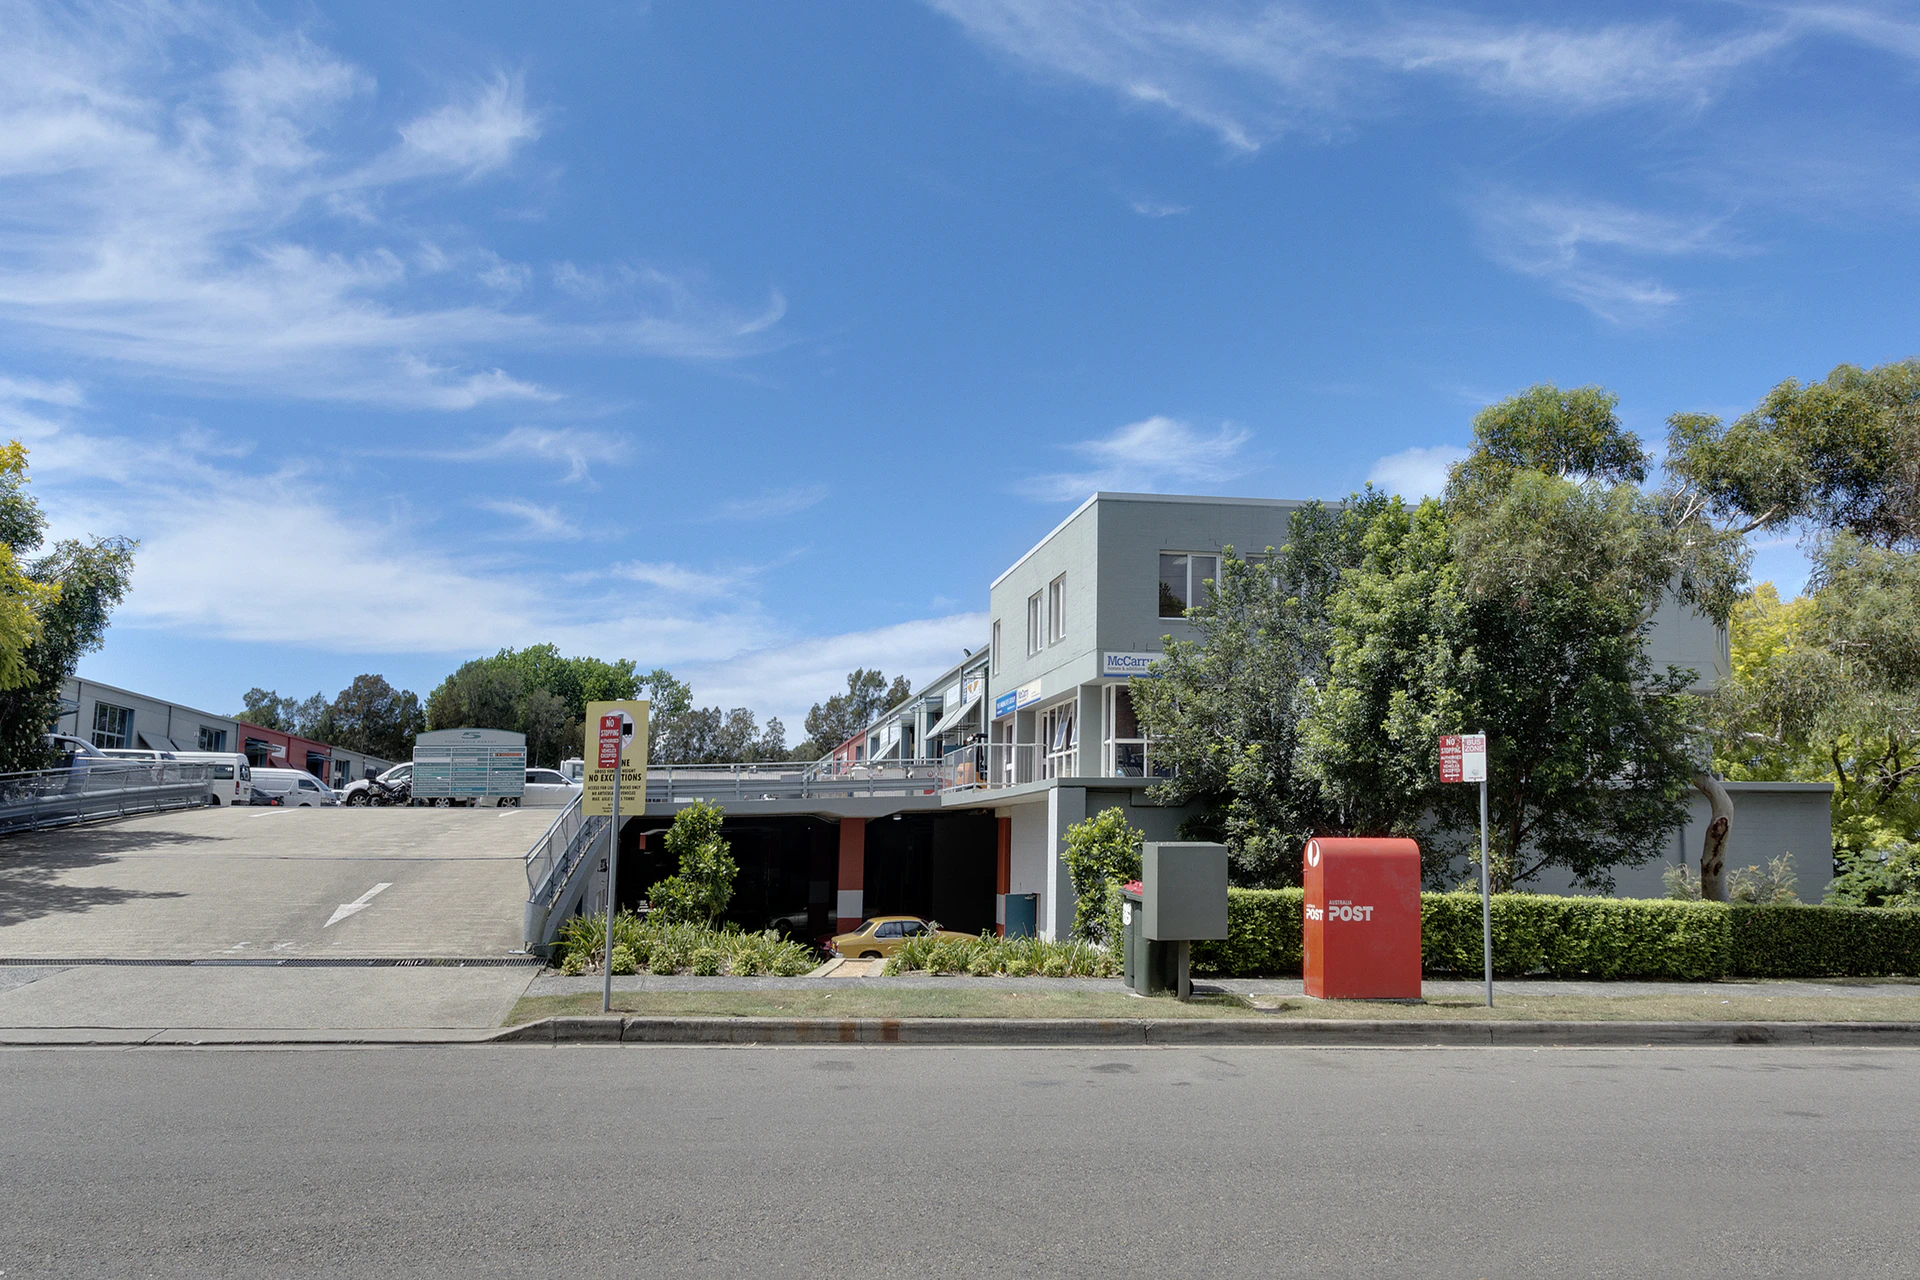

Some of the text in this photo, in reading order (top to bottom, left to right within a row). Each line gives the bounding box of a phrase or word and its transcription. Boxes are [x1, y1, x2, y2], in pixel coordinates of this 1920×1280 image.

[606, 719, 615, 727] NO
[1446, 738, 1456, 746] NO
[588, 773, 642, 782] NO EXCTIONS
[1306, 908, 1324, 921] POST
[1329, 906, 1374, 921] POST
